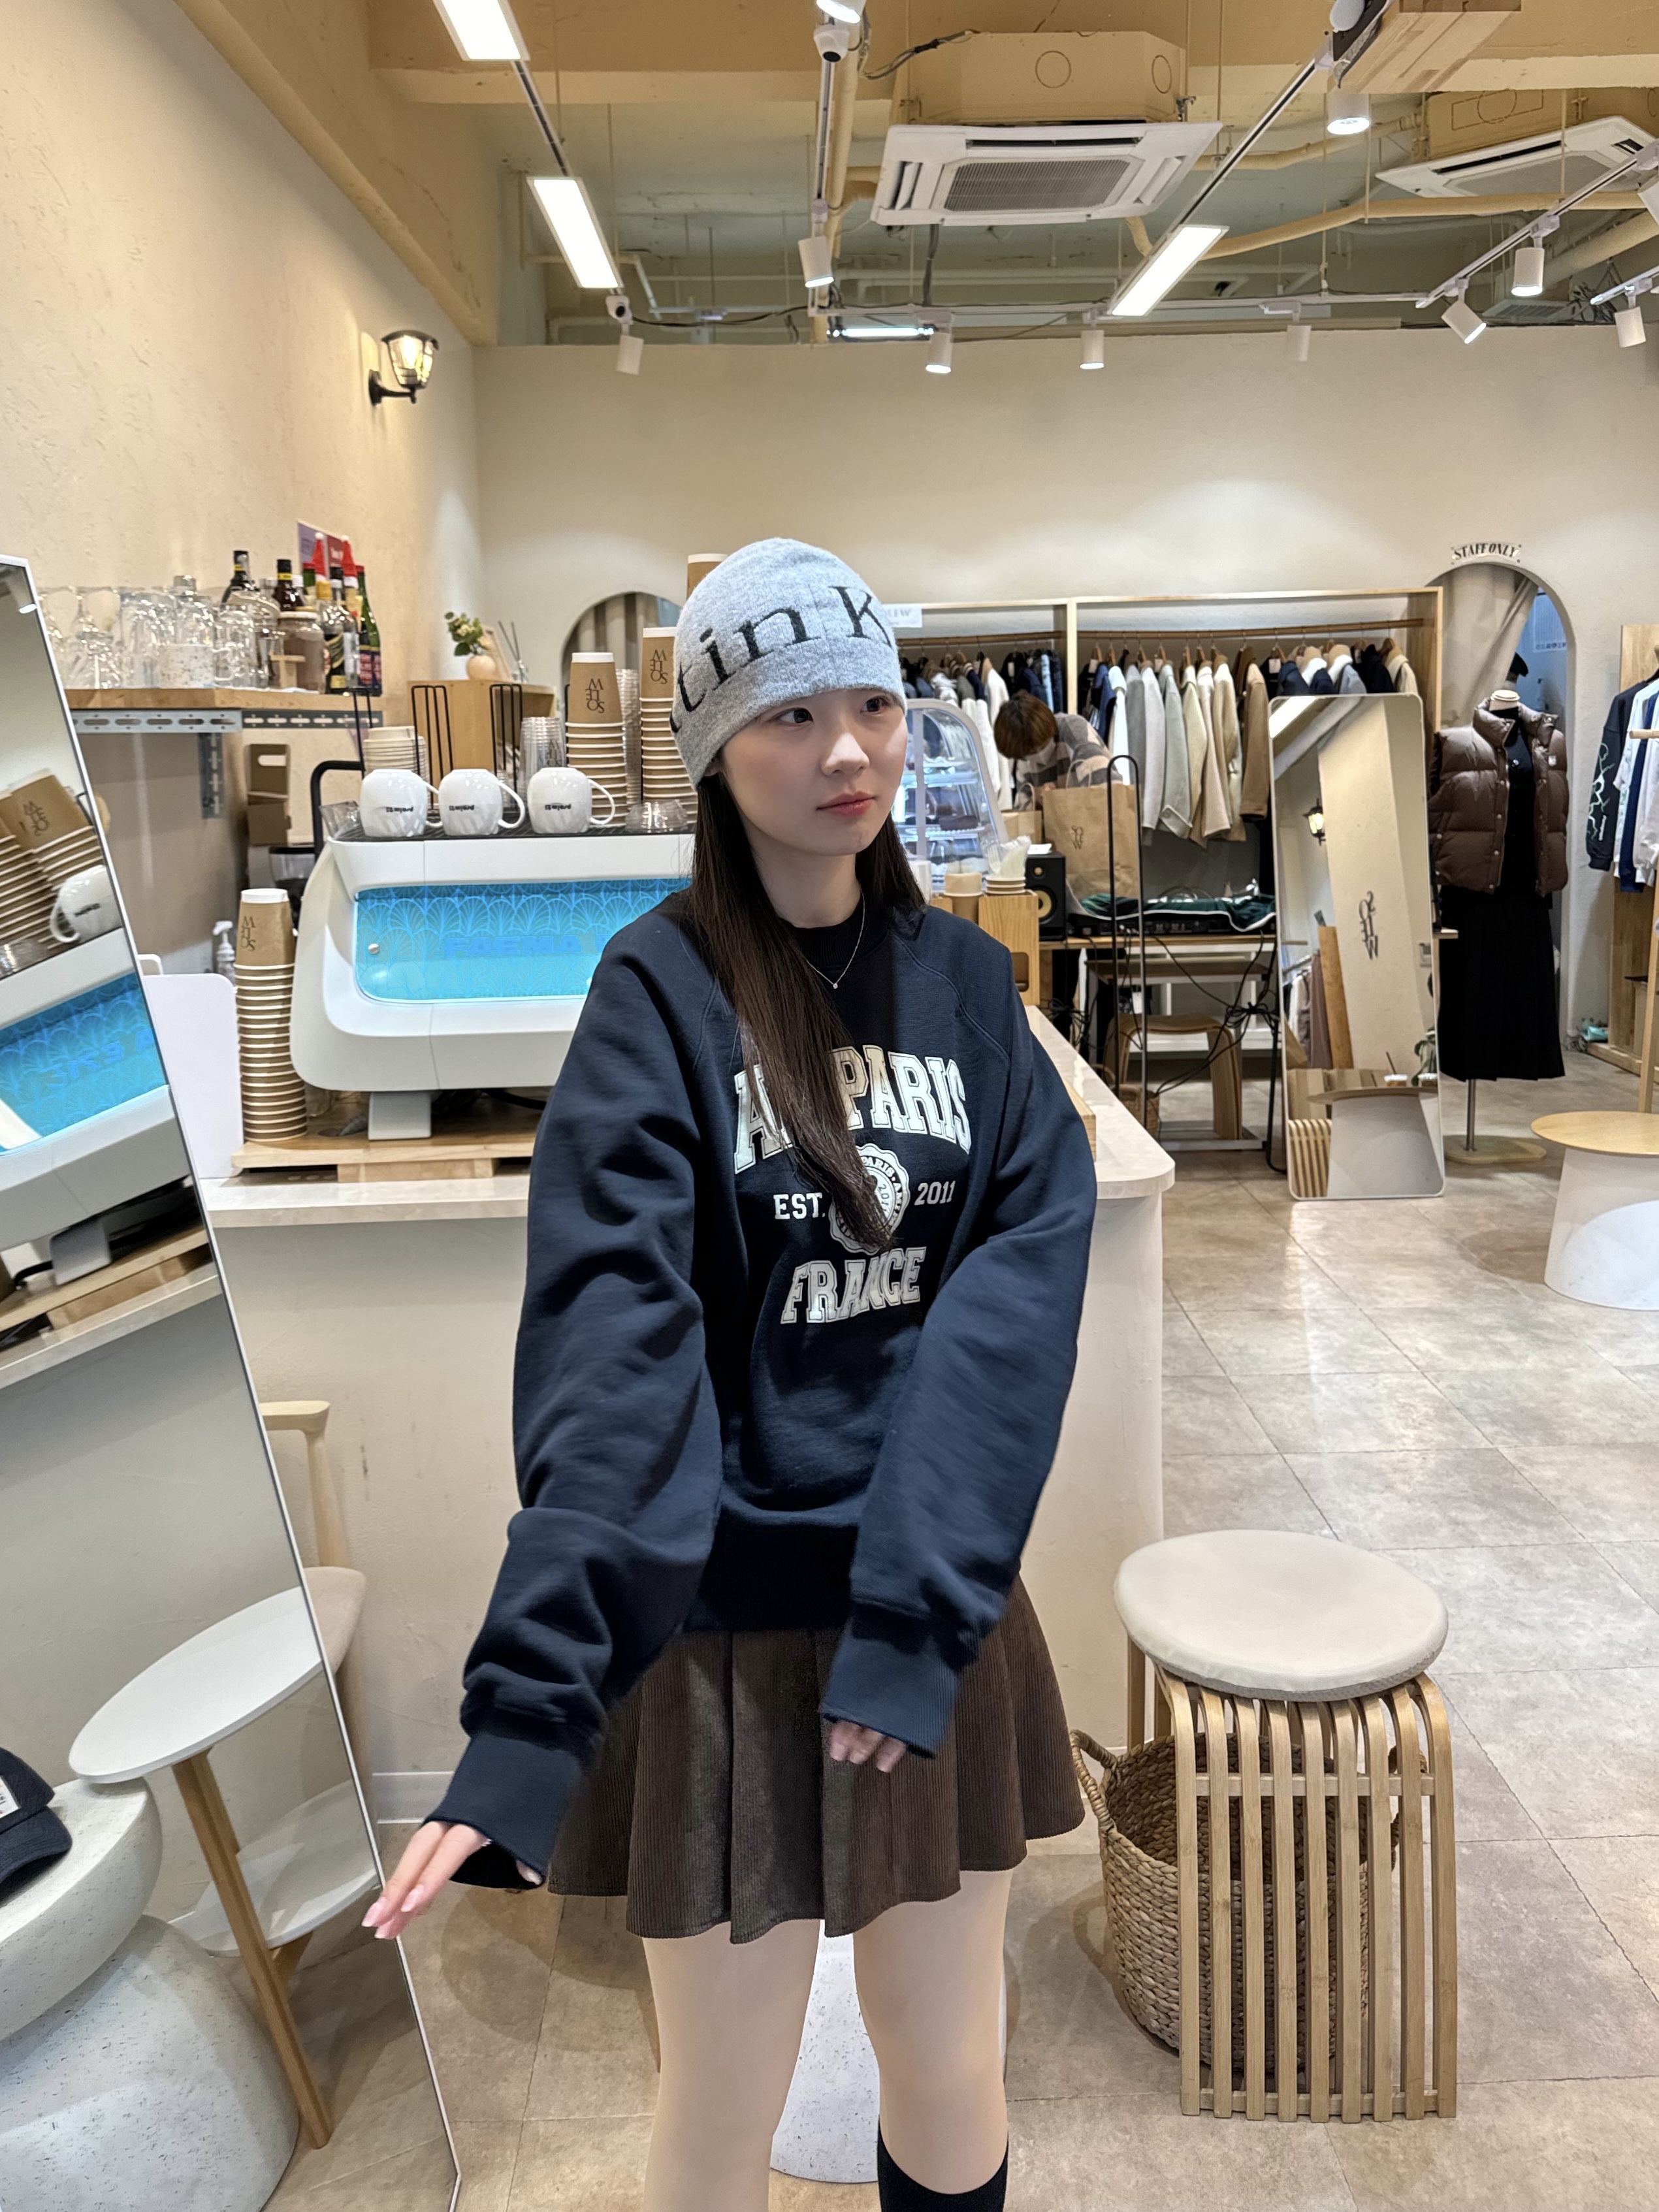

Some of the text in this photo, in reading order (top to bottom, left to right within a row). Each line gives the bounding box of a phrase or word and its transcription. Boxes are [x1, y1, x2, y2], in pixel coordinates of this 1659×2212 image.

[1454, 543, 1517, 560] STAFF ONLY
[669, 607, 821, 733] tin
[830, 1045, 972, 1155] PARIS
[773, 1180, 956, 1220] EST. 2011
[781, 1246, 926, 1324] FRANCE
